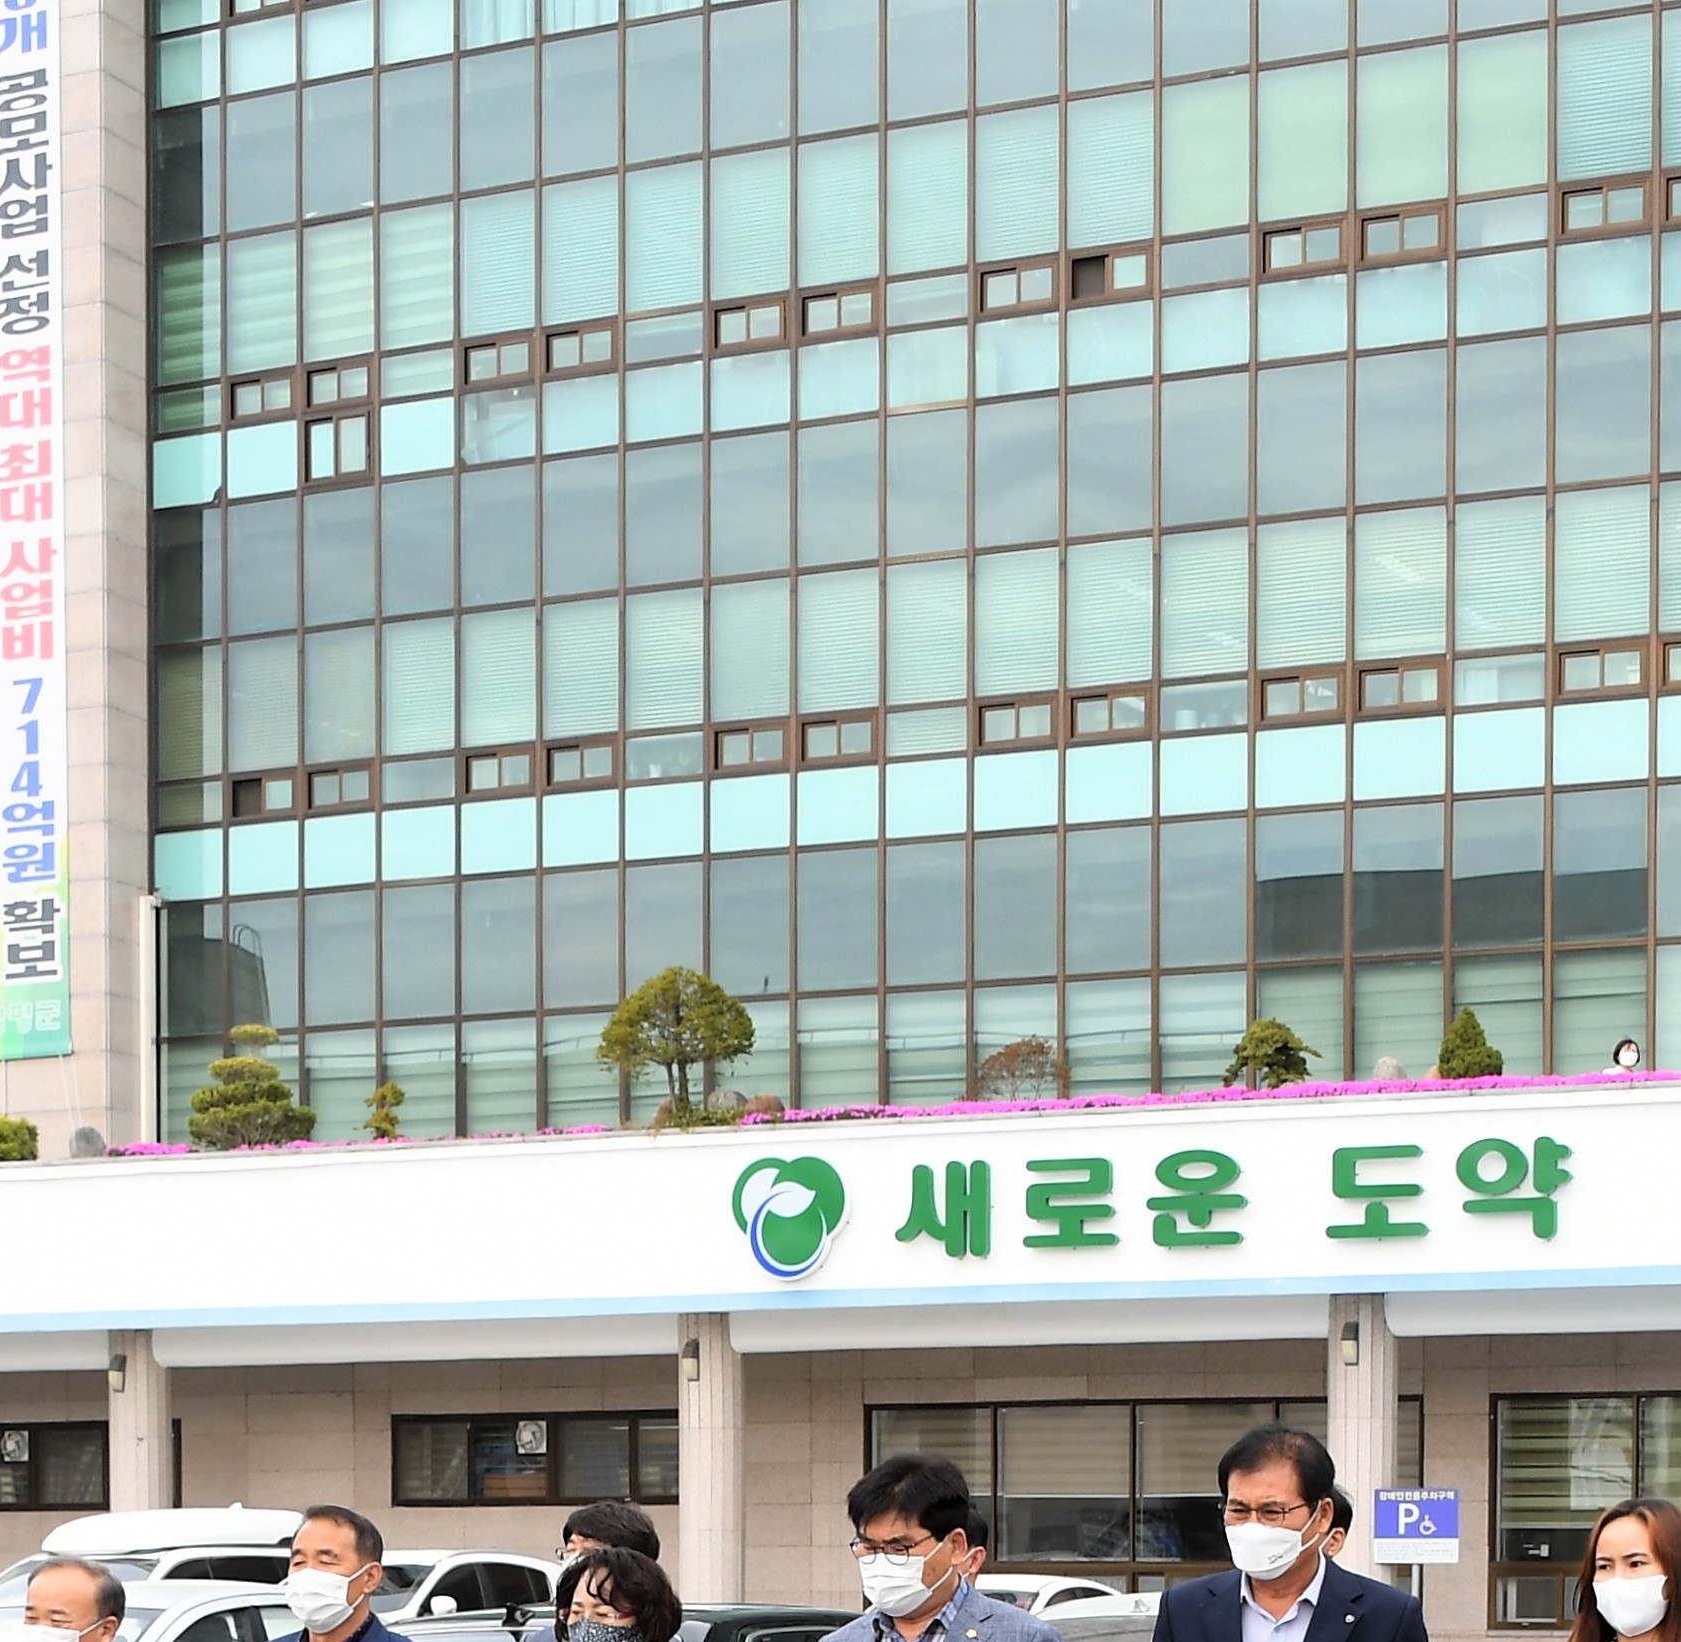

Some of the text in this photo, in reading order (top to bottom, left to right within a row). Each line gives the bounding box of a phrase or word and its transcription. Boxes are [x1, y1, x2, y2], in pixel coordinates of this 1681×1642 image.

[0, 438, 54, 524] 최대
[2, 677, 56, 884] 714억원
[2, 898, 61, 982] 확보
[897, 1151, 1247, 1257] 새로운
[1327, 1137, 1572, 1239] 도약
[1398, 1503, 1420, 1536] P
